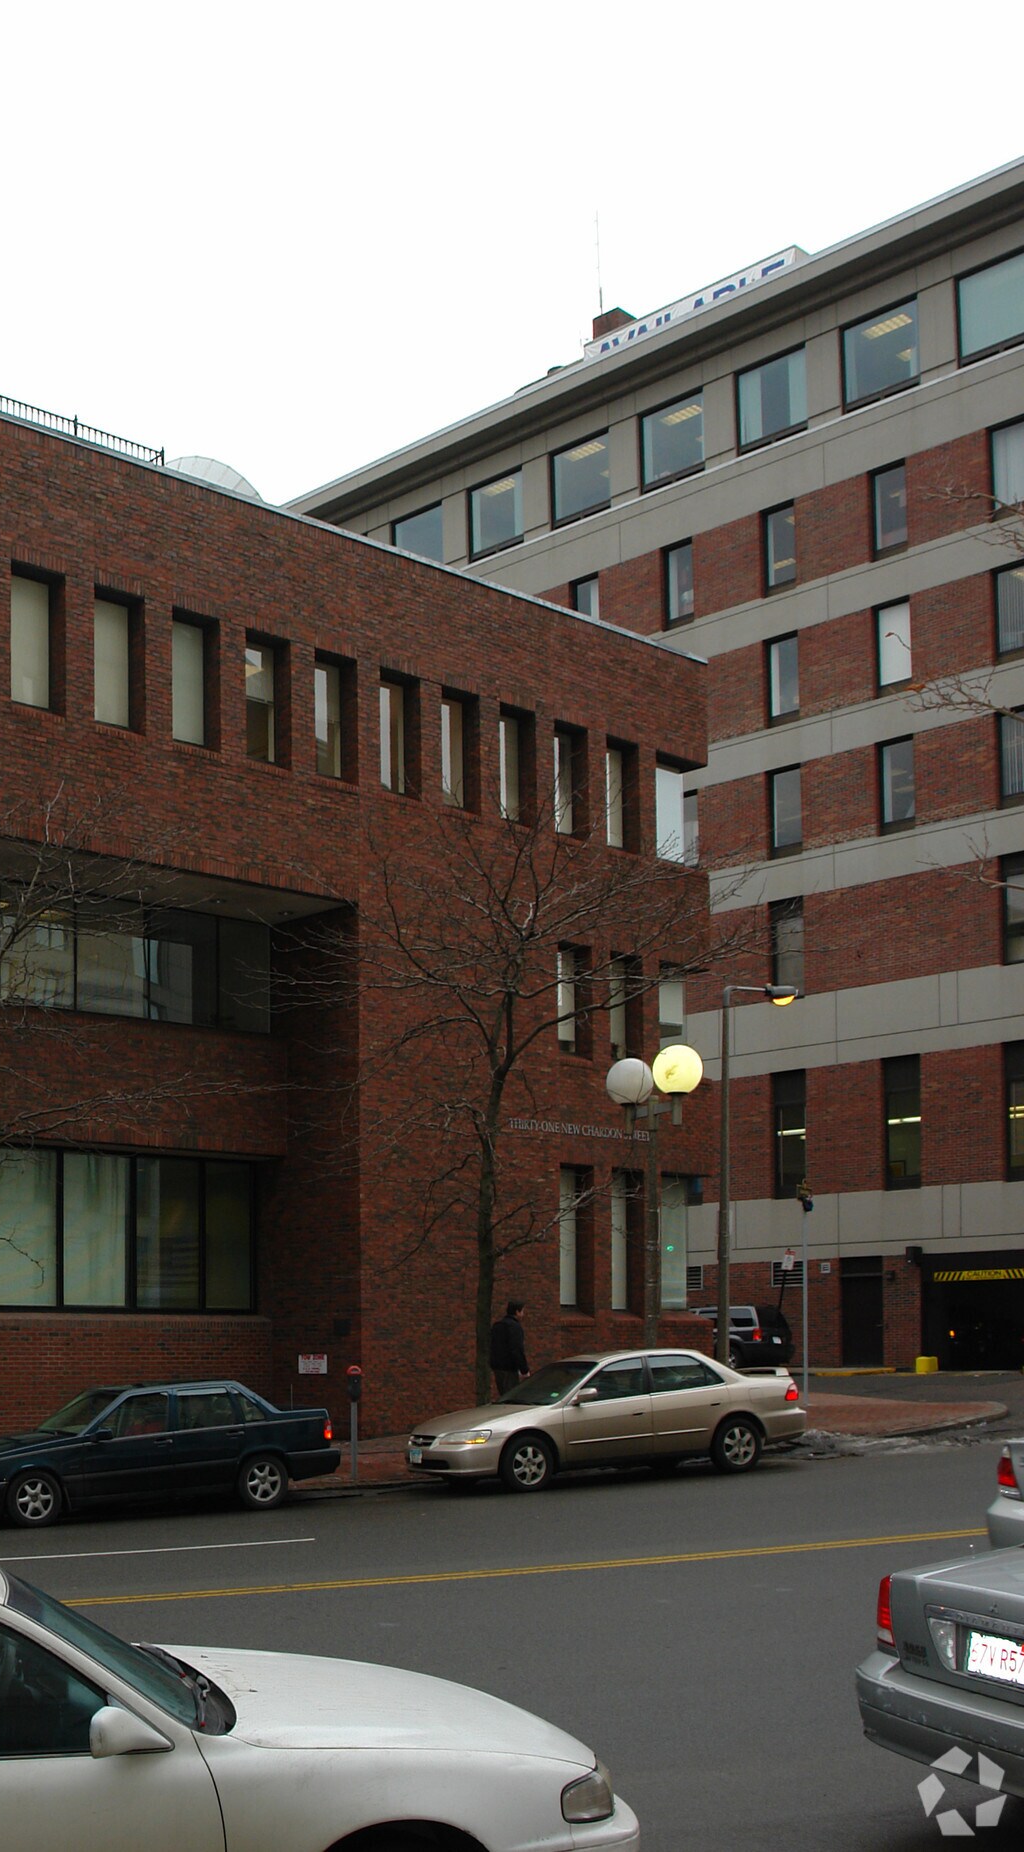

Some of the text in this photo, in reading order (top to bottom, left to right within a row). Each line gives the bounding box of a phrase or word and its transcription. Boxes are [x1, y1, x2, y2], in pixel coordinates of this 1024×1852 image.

[508, 1117, 560, 1133] THIRTY-ONE
[561, 1122, 581, 1136] NEW
[581, 1124, 623, 1140] CHARDON
